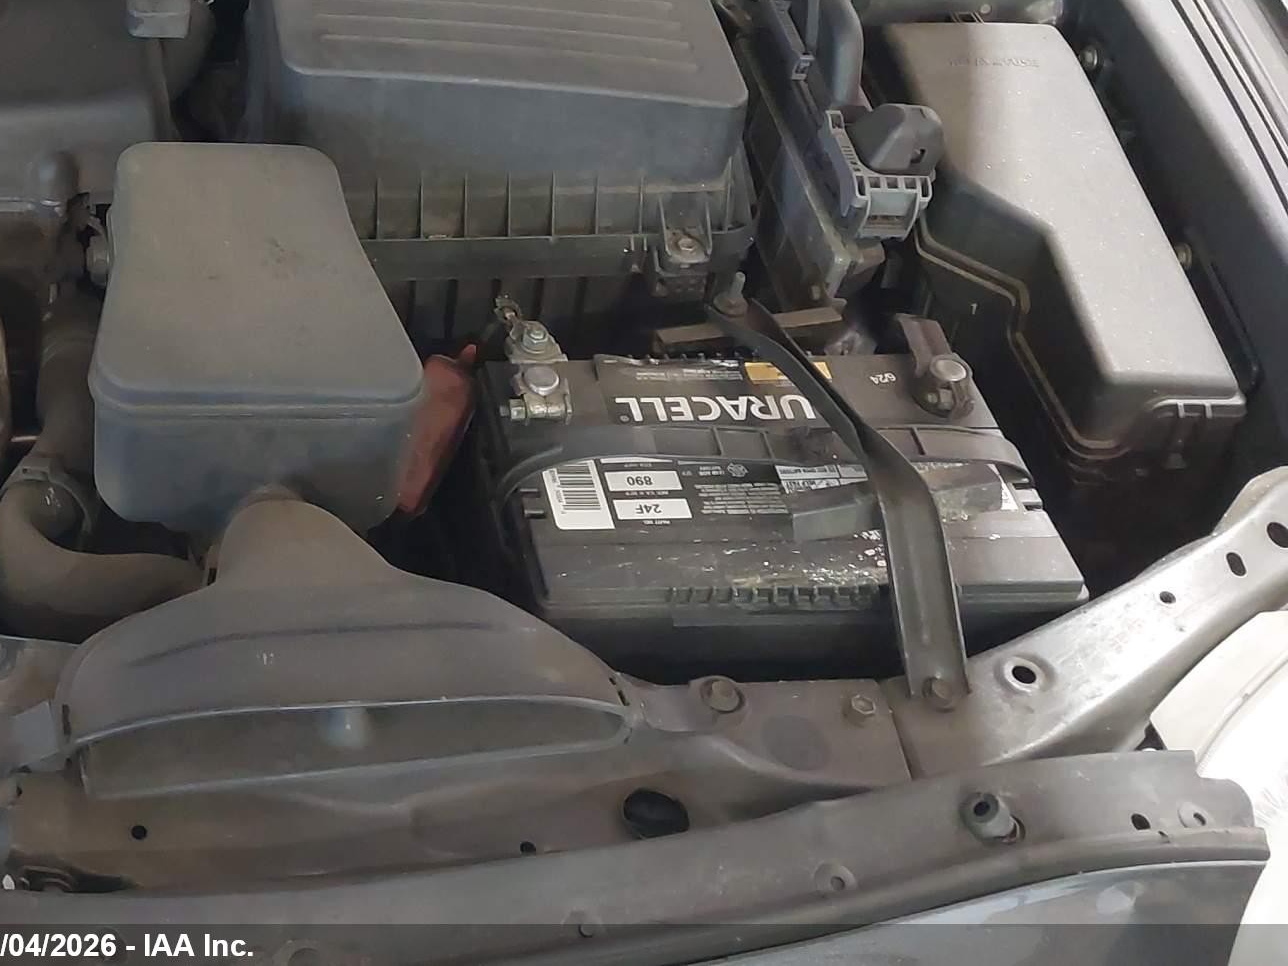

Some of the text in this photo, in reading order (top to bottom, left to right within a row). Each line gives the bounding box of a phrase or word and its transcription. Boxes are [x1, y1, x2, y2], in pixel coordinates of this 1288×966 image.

[615, 394, 816, 422] URACELL
[626, 476, 653, 486] 890
[635, 503, 662, 514] 24F
